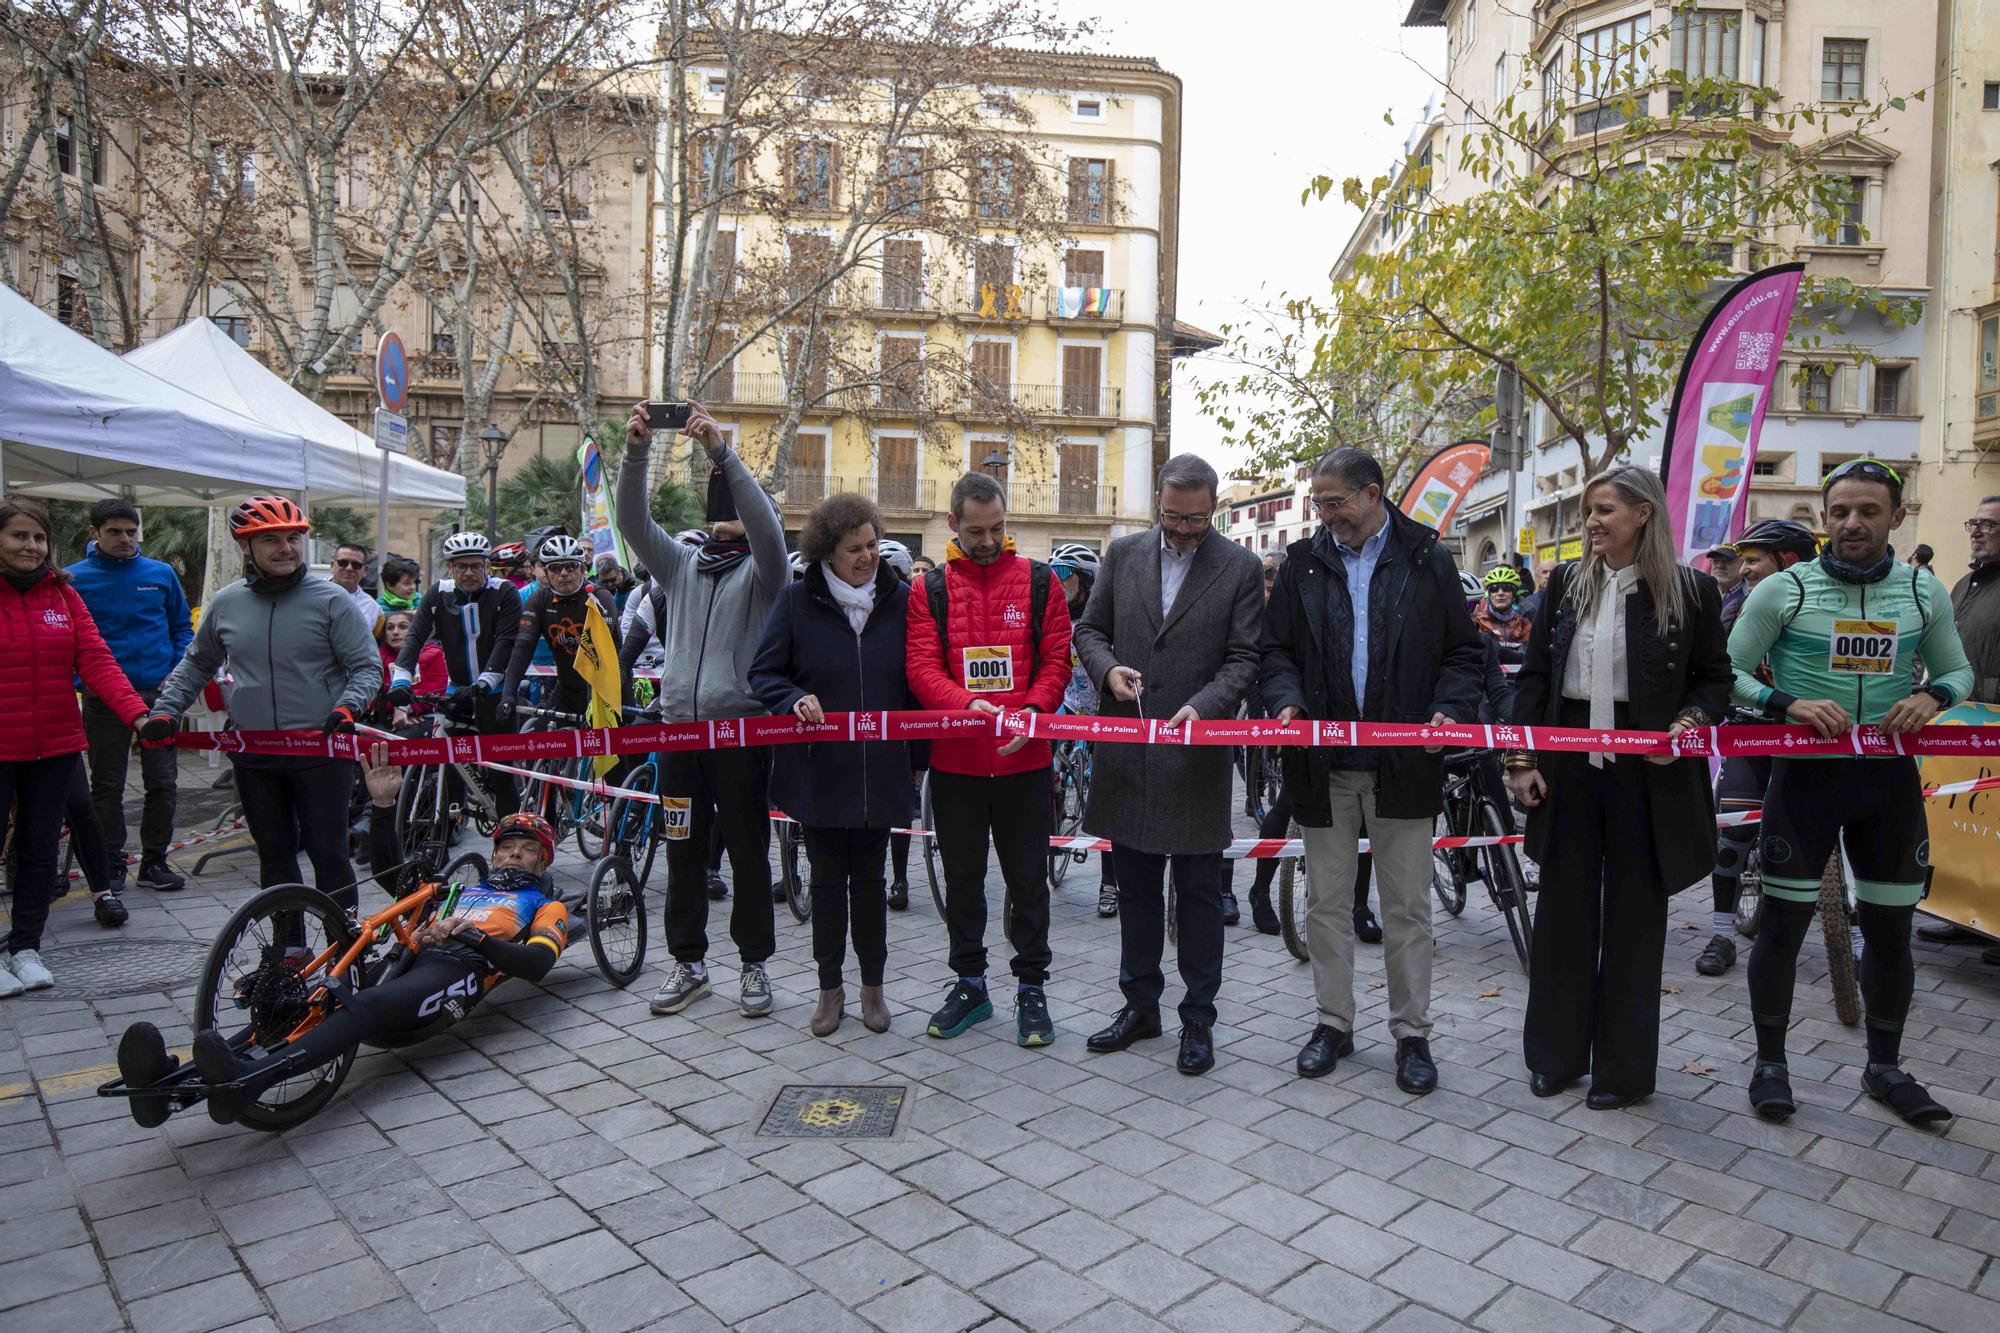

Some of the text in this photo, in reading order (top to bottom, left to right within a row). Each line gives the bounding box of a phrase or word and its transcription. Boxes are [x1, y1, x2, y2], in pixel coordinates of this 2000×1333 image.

[1836, 636, 1893, 658] 0002
[969, 660, 1008, 678] 0001
[756, 722, 839, 736] Ajuntament de Palma
[857, 721, 877, 731] IME
[899, 718, 986, 730] Ajuntament de Palma
[1004, 719, 1025, 729] IME
[1048, 722, 1138, 734] Ajuntament de Palma
[717, 729, 735, 739] IME
[1158, 727, 1180, 736] IME
[1205, 727, 1301, 737] Ajuntament de Palma
[1322, 729, 1345, 738] IME
[1371, 730, 1418, 739] Ajuntament
[1445, 730, 1473, 739] Palma
[621, 733, 700, 745] Ajuntament de Palma
[1496, 733, 1520, 742] IME
[1549, 735, 1658, 745] Ajuntament de Palma
[1733, 737, 1781, 748] Ajuntament
[1796, 737, 1809, 745] de
[1862, 735, 1888, 746] IME
[334, 742, 351, 752] IME
[492, 741, 567, 753] Ajuntament de Palma
[583, 738, 601, 748] IME
[1681, 738, 1705, 749] IME
[1917, 738, 1968, 748] Ajuntament
[1983, 738, 1995, 746] de
[409, 749, 419, 757] de
[419, 748, 440, 756] Palma
[454, 745, 473, 755] IME
